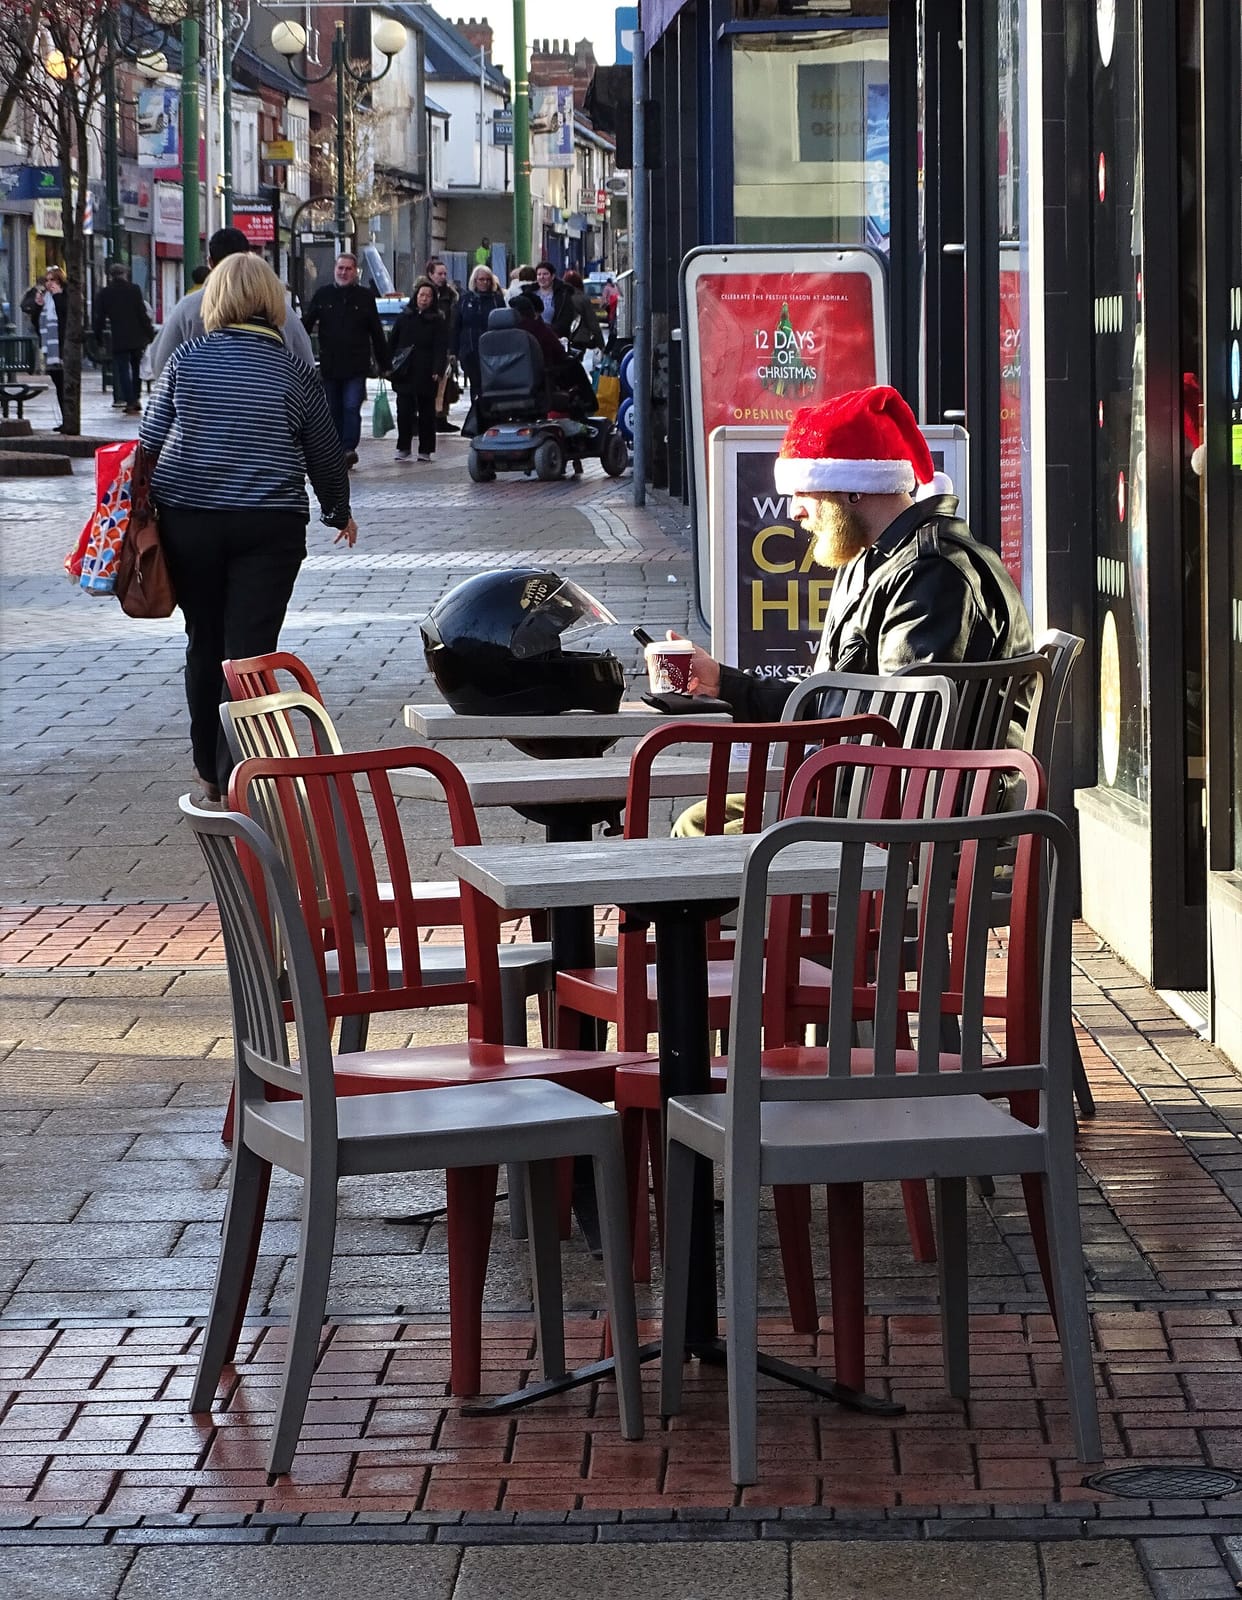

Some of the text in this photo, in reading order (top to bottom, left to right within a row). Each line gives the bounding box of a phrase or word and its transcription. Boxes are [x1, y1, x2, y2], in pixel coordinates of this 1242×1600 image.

[252, 216, 274, 224] to let
[754, 329, 815, 350] 12 DAYS
[777, 350, 795, 364] OF
[757, 366, 817, 380] CHRISTMAS
[733, 408, 793, 421] OPENING
[754, 664, 784, 679] ASK
